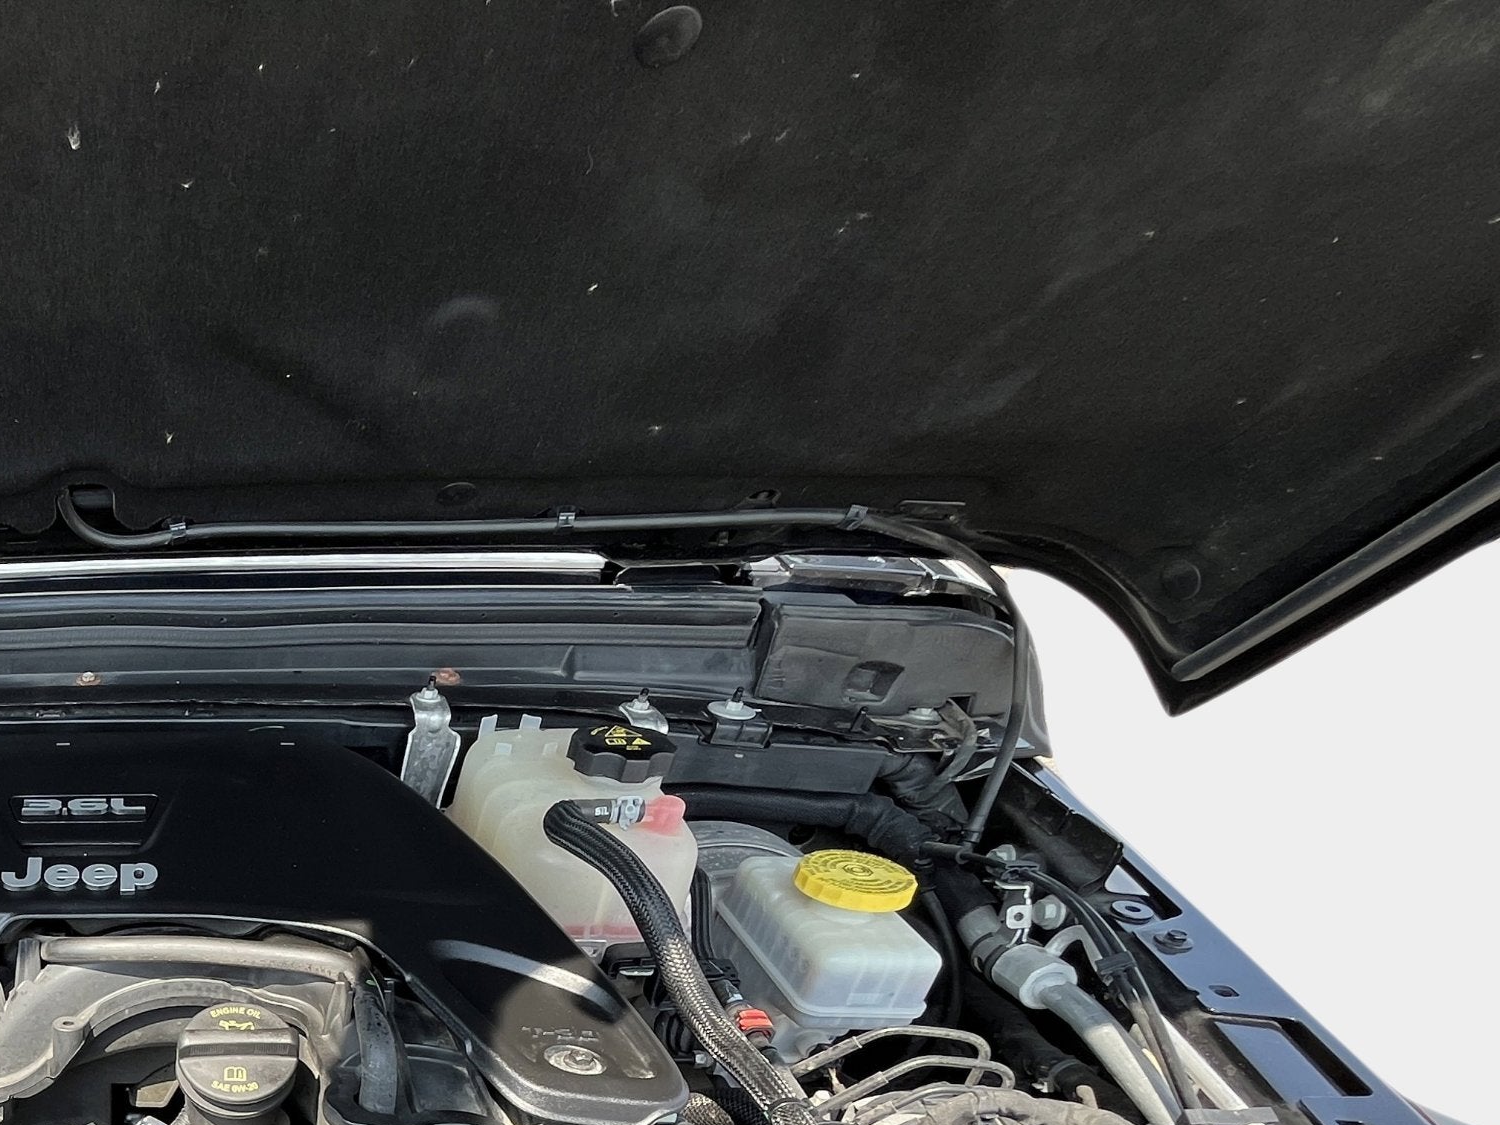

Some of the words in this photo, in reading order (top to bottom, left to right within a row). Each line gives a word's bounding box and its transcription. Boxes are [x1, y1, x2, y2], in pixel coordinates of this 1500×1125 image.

[21, 798, 146, 816] 3.6L
[1, 857, 158, 896] Jeep
[209, 1006, 245, 1018] ENGINE
[246, 1008, 261, 1019] OIL
[211, 1080, 230, 1092] SAE
